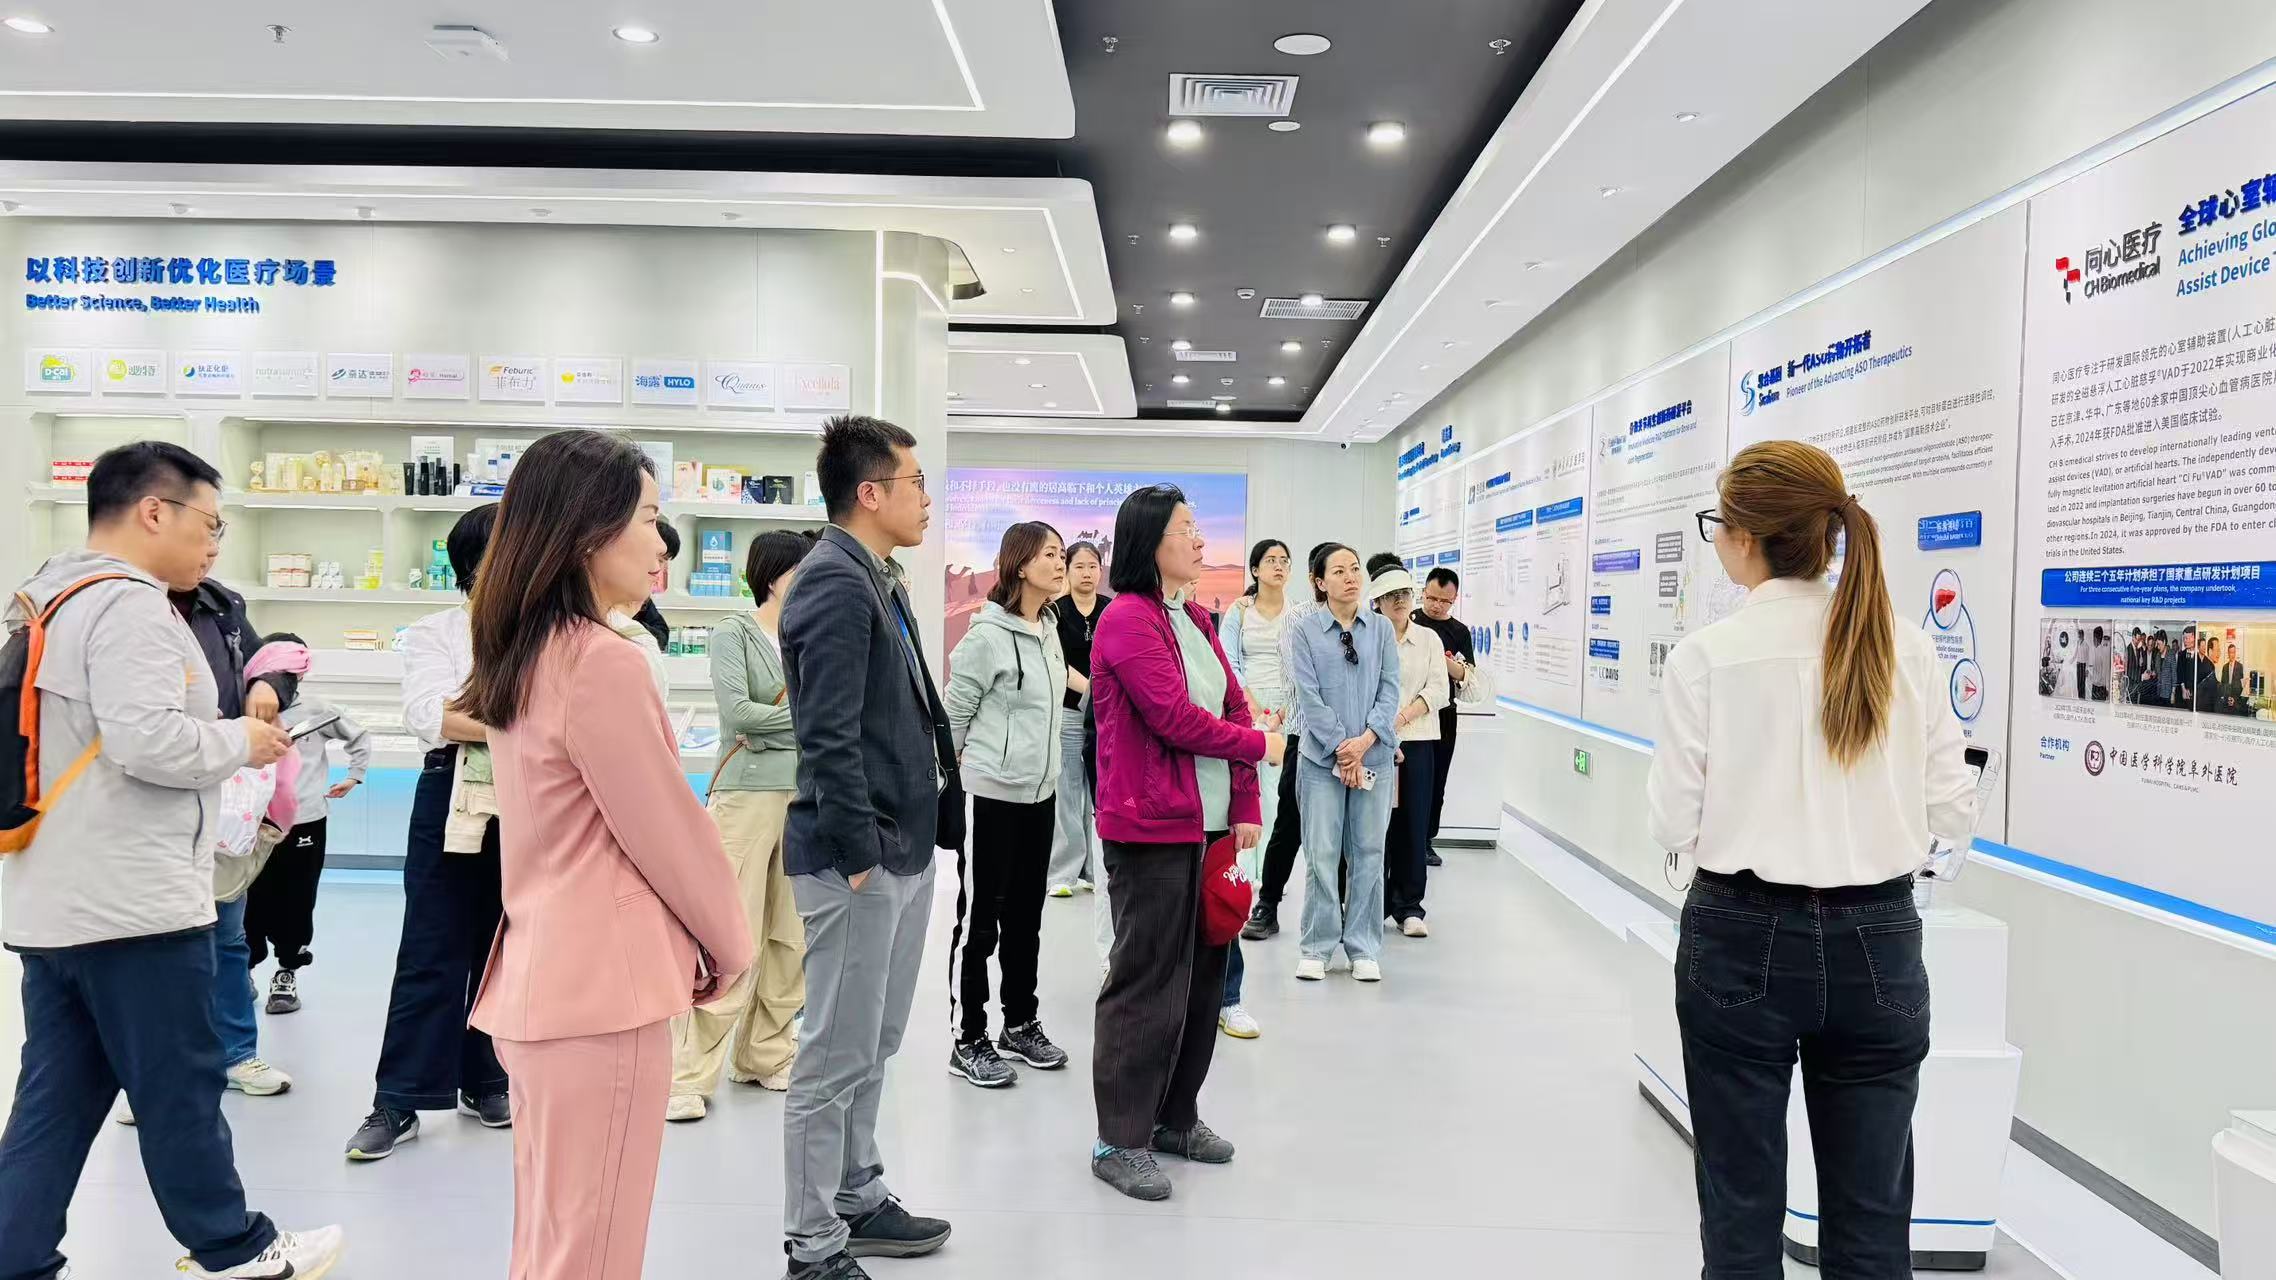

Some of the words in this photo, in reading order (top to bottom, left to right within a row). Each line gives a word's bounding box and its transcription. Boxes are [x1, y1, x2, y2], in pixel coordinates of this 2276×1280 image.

[2085, 221, 2162, 277] 同心医疗
[2178, 230, 2248, 267] Achieving
[25, 256, 337, 287] 以科技创新优化医疗场景
[2084, 281, 2099, 298] CH
[2100, 256, 2162, 293] Biomedical
[2177, 269, 2217, 297] Assist
[2221, 256, 2270, 285] Device
[25, 293, 76, 312] Better
[80, 294, 148, 314] Science,
[150, 295, 200, 313] Better
[204, 296, 261, 314] Health
[635, 376, 660, 387] 海露
[667, 378, 691, 387] HYLO
[1786, 384, 1806, 398] Pioneer
[1807, 380, 1814, 391] of
[1814, 376, 1823, 389] the
[1823, 366, 1854, 385] Advancing
[1854, 359, 1868, 375] ASO
[1868, 345, 1912, 370] Therapeutics
[2095, 452, 2119, 462] strives
[2120, 450, 2128, 458] to
[2129, 445, 2158, 457] develop
[2159, 435, 2218, 451] internationally
[2220, 431, 2252, 443] leading
[2048, 474, 2066, 484] assist
[2066, 471, 2091, 481] devices
[2115, 466, 2122, 475] or
[2123, 462, 2153, 474] artificial
[2155, 459, 2180, 469] hearts.
[2182, 456, 2197, 465] The
[2198, 447, 2257, 464] independently
[2047, 489, 2061, 499] fully
[2062, 485, 2092, 497] magnetic
[2092, 481, 2124, 493] levitation
[2126, 478, 2155, 489] artificial
[2156, 475, 2177, 485] heart
[2229, 467, 2246, 477] was
[2047, 505, 2060, 513] ized
[2060, 503, 2067, 512] in
[2068, 501, 2084, 511] 2022
[2085, 500, 2097, 510] and
[2098, 497, 2141, 508] implantation
[2141, 493, 2175, 504] surgeries
[2177, 491, 2196, 500] have
[2197, 489, 2222, 499] begun
[2223, 485, 2232, 496] in
[2233, 486, 2253, 495] over
[2254, 482, 2266, 492] 60
[2081, 514, 2111, 526] hospitals
[2111, 514, 2119, 523] in
[2120, 512, 2146, 524] Beijing,
[2147, 509, 2174, 520] Tianjin,
[2175, 506, 2203, 518] Central
[2204, 504, 2230, 515] China,
[2045, 534, 2063, 543] other
[2099, 530, 2119, 540] 2024,
[2121, 529, 2127, 538] it
[2128, 528, 2144, 538] was
[2144, 525, 2181, 538] approved
[2182, 524, 2193, 536] by
[2194, 523, 2209, 533] the
[2210, 522, 2228, 532] FDA
[2230, 521, 2240, 531] to
[2241, 520, 2266, 530] enter
[2045, 549, 2061, 558] trials
[2061, 548, 2068, 557] in
[2068, 547, 2079, 557] the
[2080, 545, 2101, 556] United
[2064, 565, 2260, 583] 公司连续三个五年计划承担了国家重点研发计划项目
[2080, 585, 2088, 593] For
[2088, 585, 2101, 593] three
[2101, 585, 2130, 593] consecutive
[2130, 585, 2153, 594] five-year
[2153, 584, 2169, 593] plans,
[2169, 584, 2179, 592] the
[2180, 585, 2205, 594] company
[2141, 596, 2151, 605] key
[2164, 596, 2187, 605] projects
[2040, 735, 2070, 752] 合作机构
